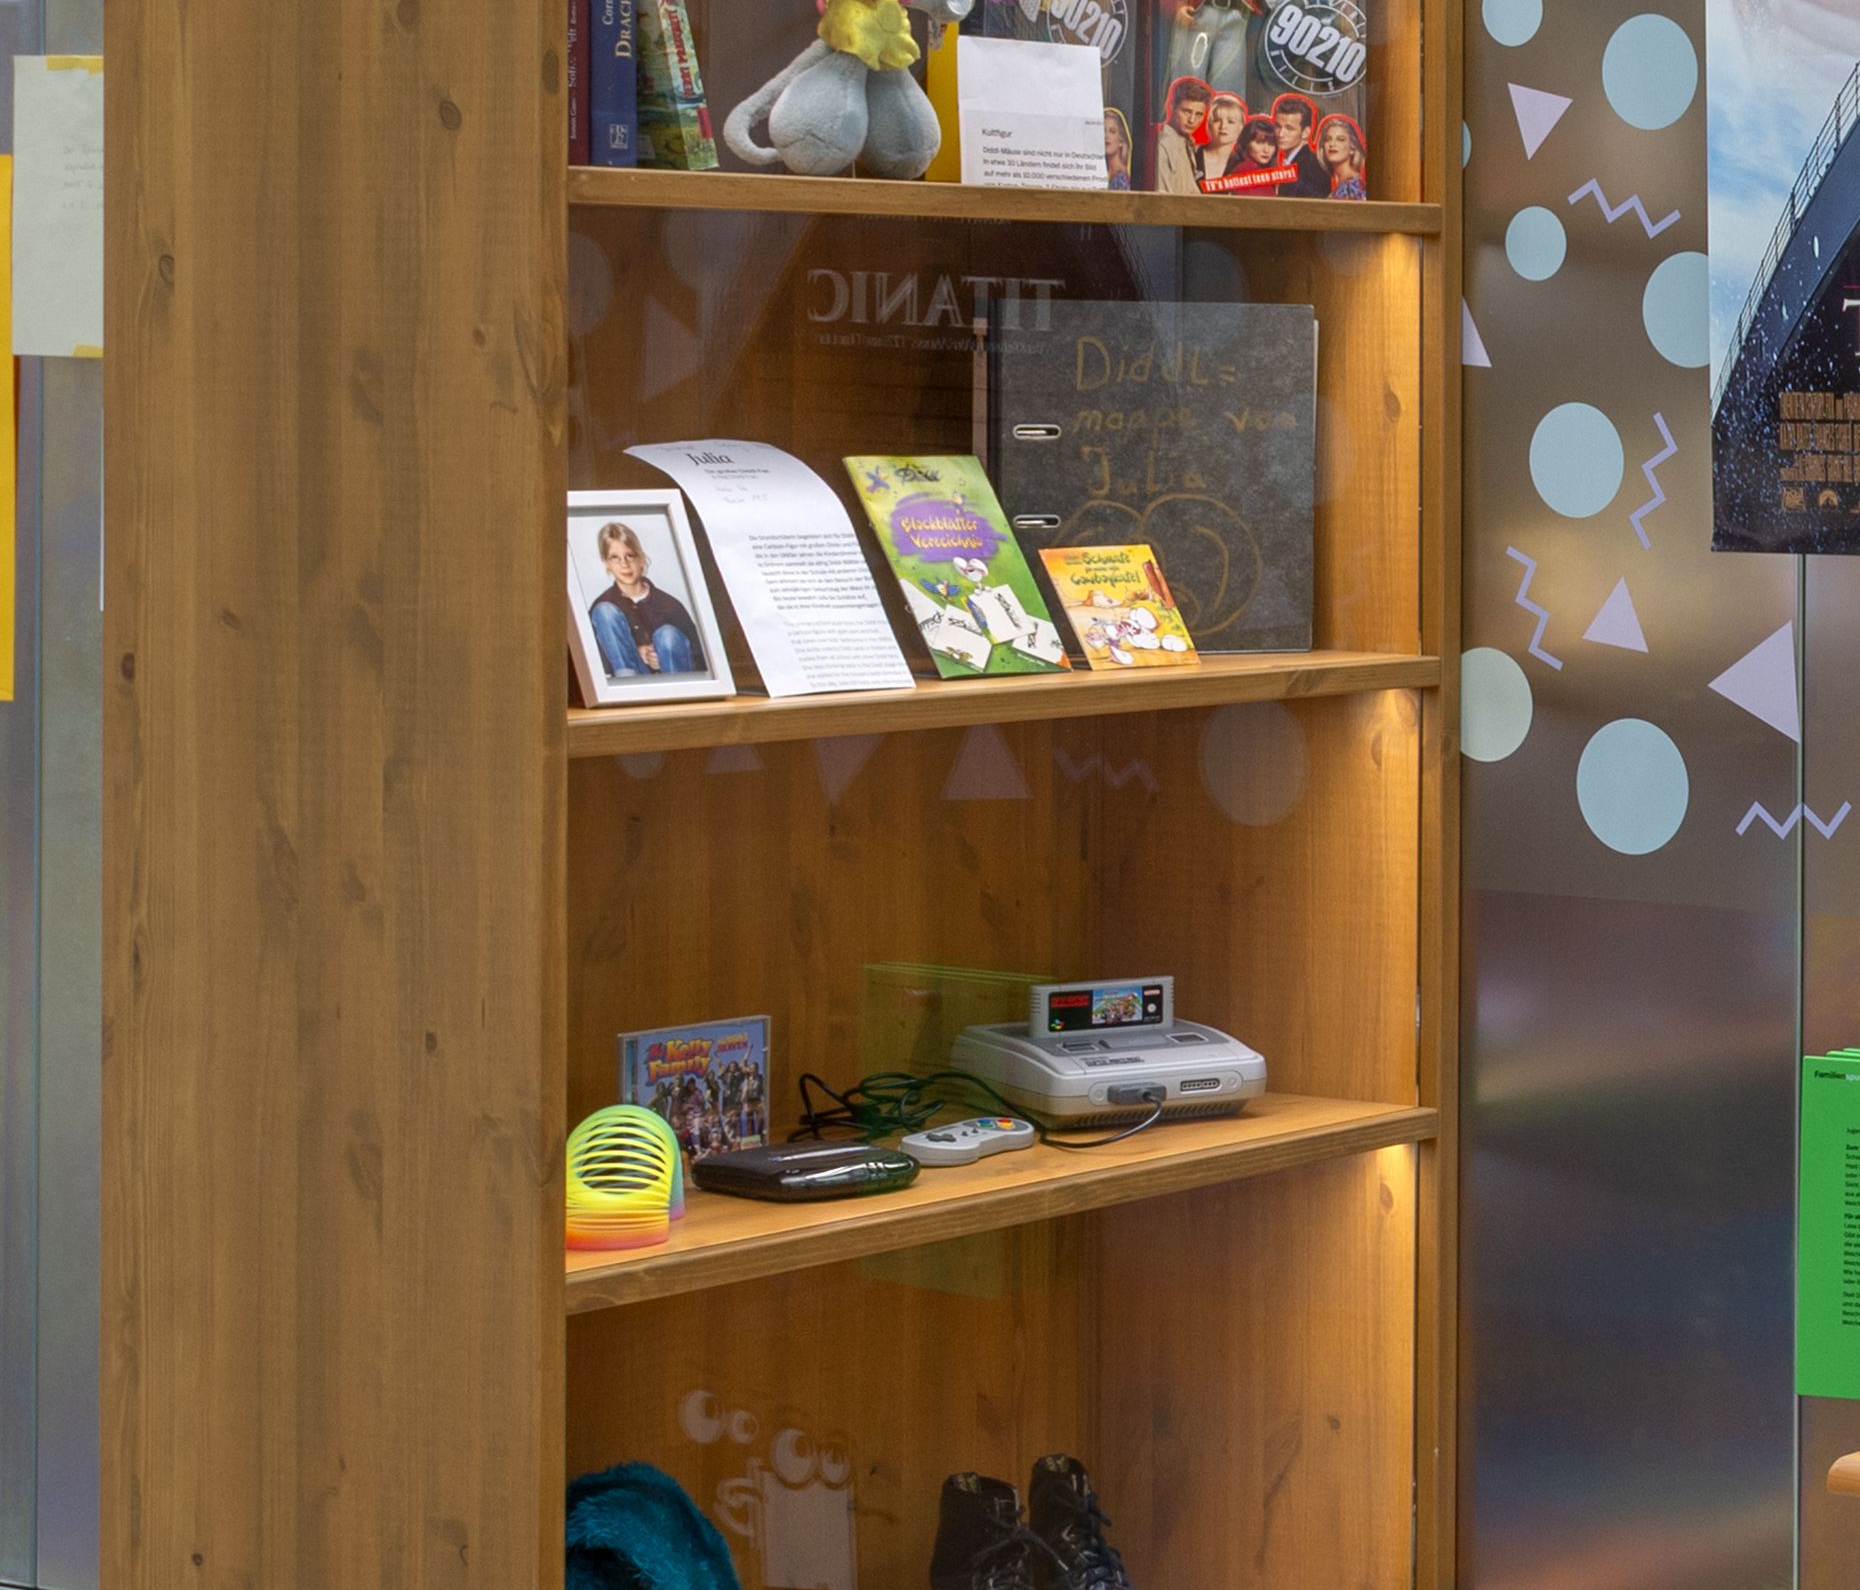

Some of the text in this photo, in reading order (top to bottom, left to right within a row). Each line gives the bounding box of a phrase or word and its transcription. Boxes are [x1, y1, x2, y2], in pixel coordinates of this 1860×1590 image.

[1270, 6, 1366, 83] 90210
[1205, 167, 1296, 191] TV's hottest teen stars!
[686, 453, 734, 466] Julia
[666, 1038, 712, 1058] Kelly
[648, 1056, 711, 1082] Family
